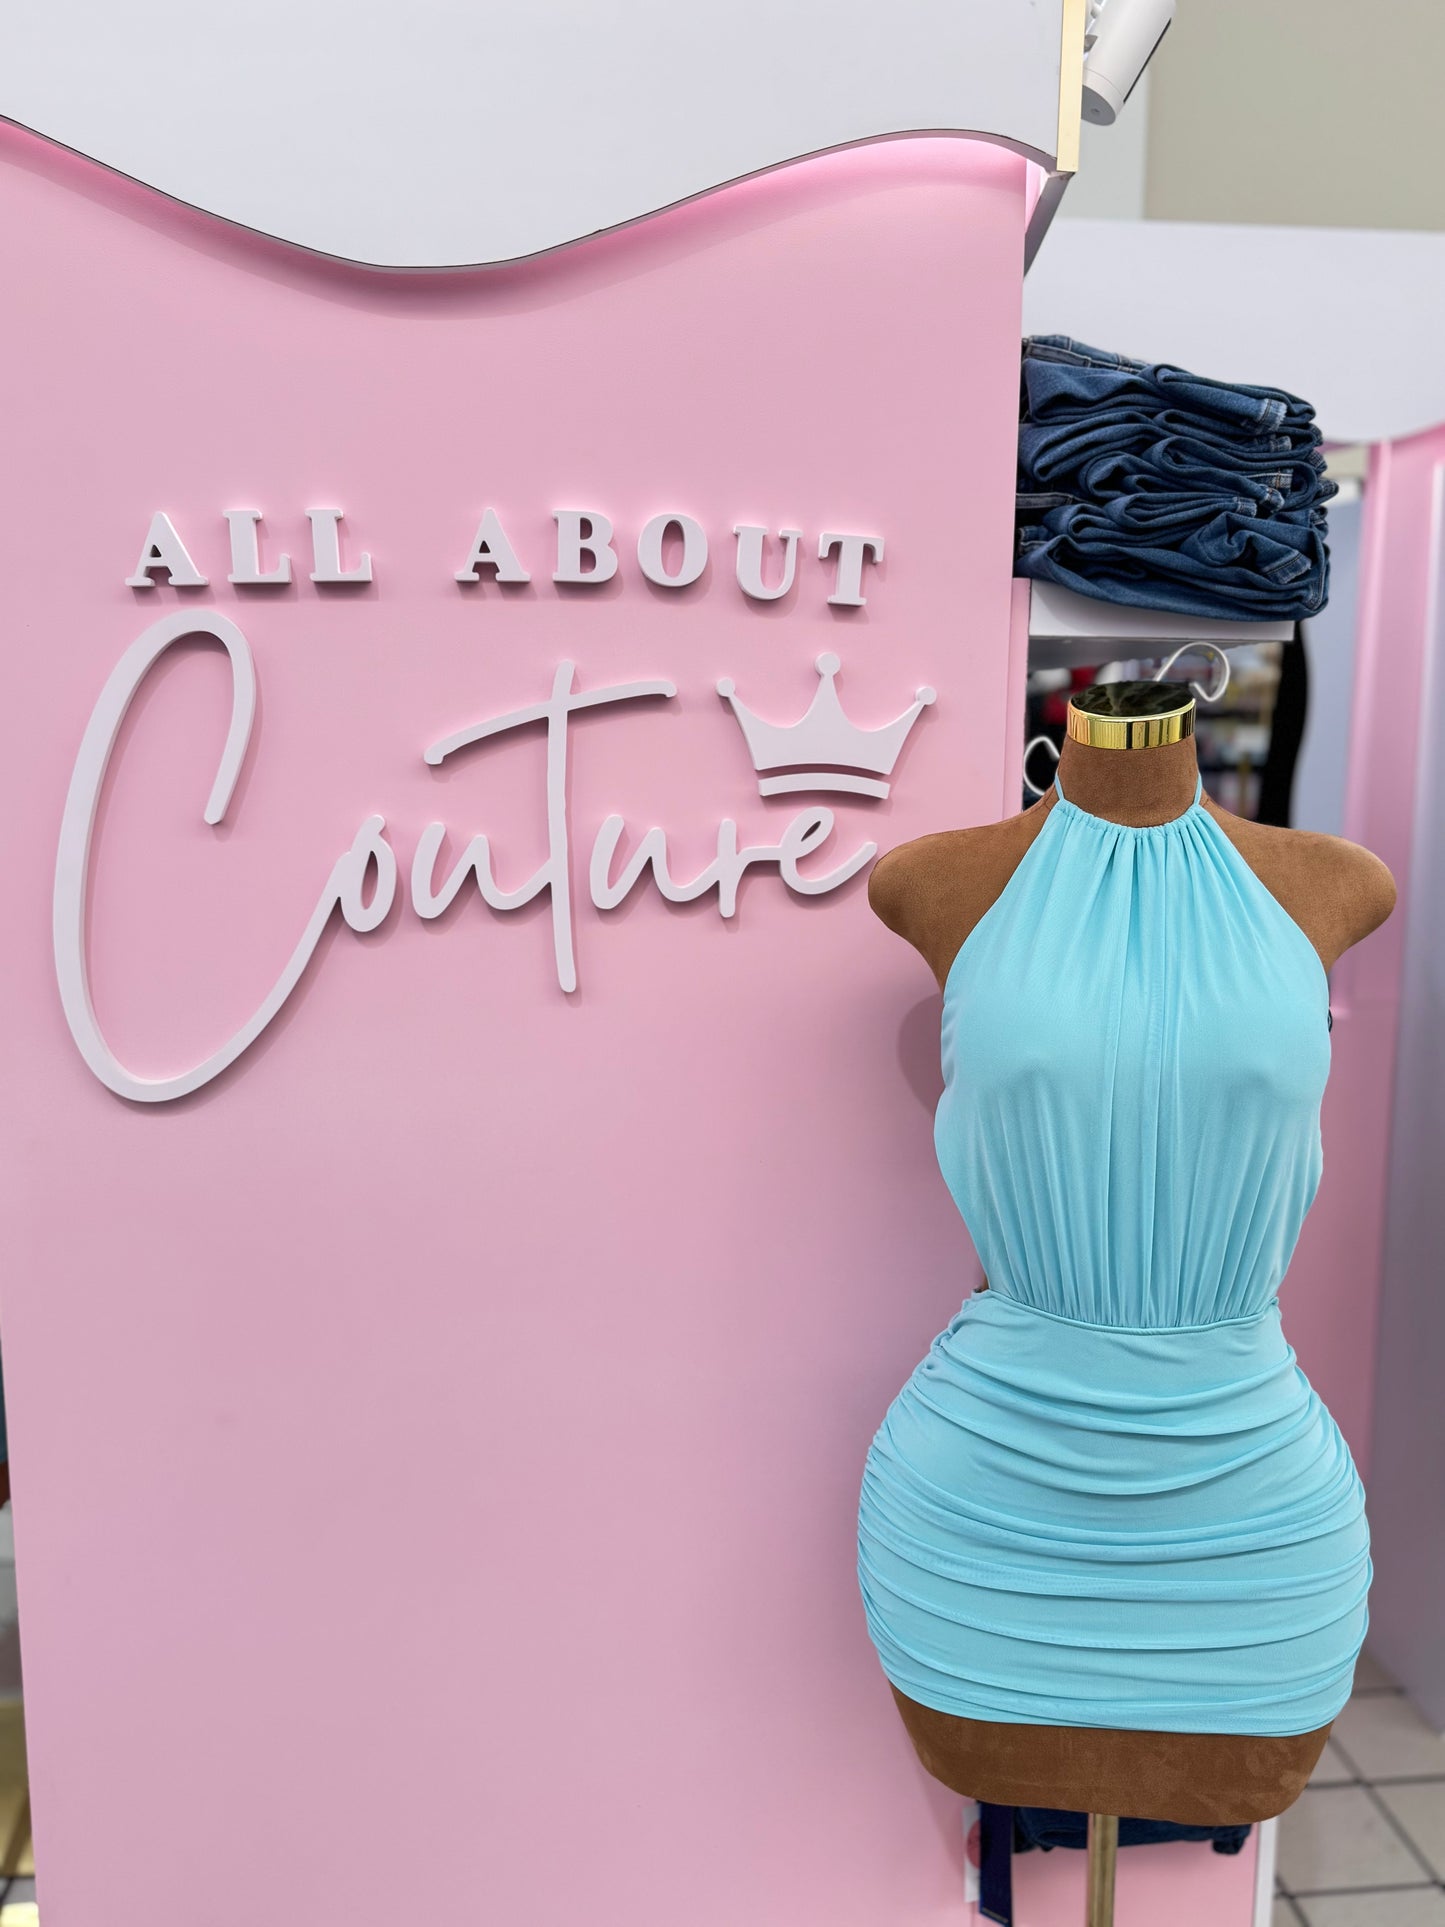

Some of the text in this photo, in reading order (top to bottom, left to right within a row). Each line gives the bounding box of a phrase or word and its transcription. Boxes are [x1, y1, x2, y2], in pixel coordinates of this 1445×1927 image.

[125, 508, 885, 607] ALL ABOUT
[52, 608, 879, 1103] Couture
